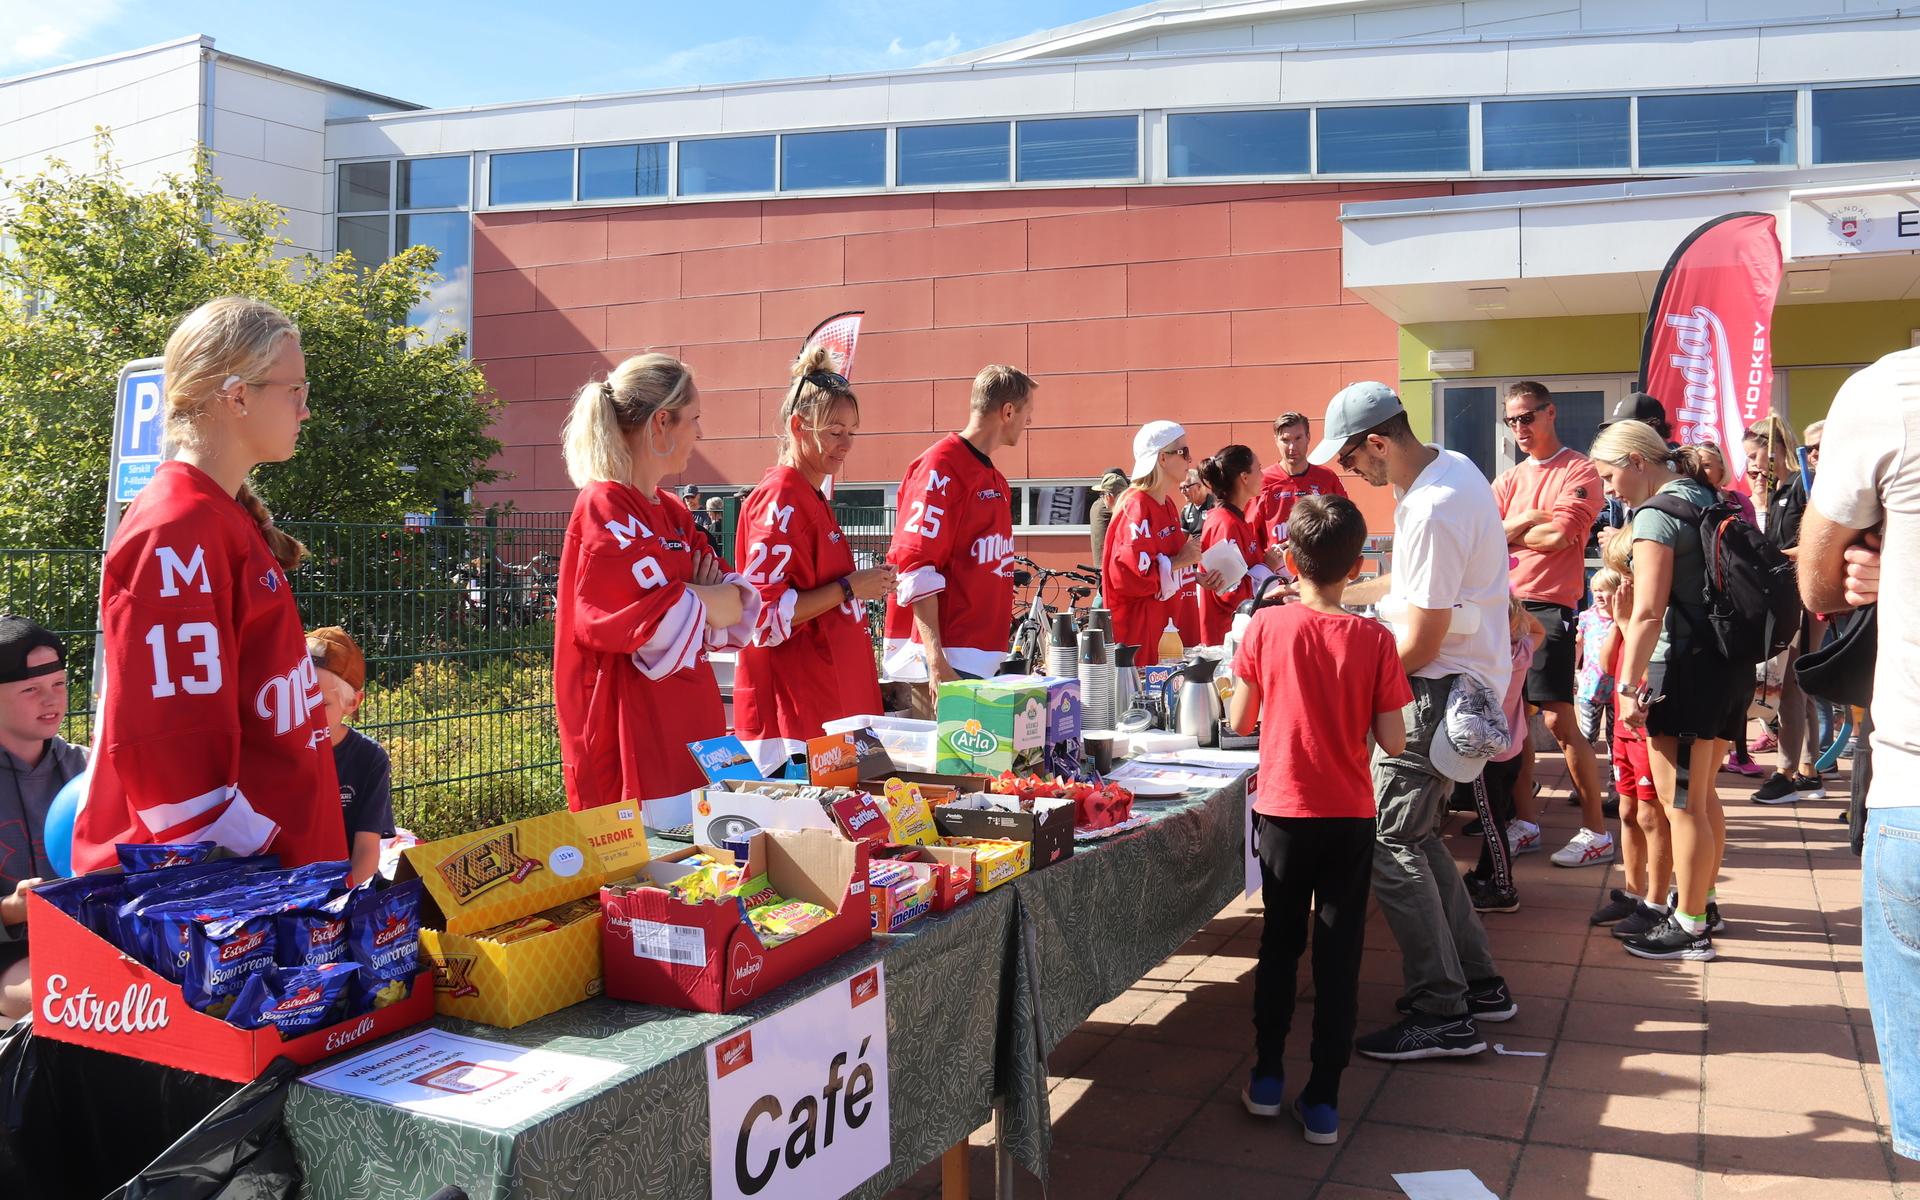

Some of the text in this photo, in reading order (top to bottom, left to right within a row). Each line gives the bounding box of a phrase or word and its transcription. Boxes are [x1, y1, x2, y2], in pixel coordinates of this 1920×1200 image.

[1666, 306, 1722, 446] ölndal
[1744, 321, 1766, 419] HOCKEY
[131, 382, 160, 449] P
[926, 469, 951, 496] M
[605, 513, 654, 550] M
[764, 500, 795, 534] M
[904, 501, 944, 539] 25
[1129, 519, 1151, 541] M
[155, 544, 212, 598] M
[632, 555, 669, 590] 9
[743, 542, 793, 585] 22
[145, 621, 223, 699] 13
[957, 733, 989, 749] Arla
[812, 747, 841, 772] CORNY
[849, 809, 879, 830] Skittles
[588, 828, 634, 848] BLERONE
[444, 832, 517, 897] KEX
[745, 888, 776, 909] ARIBO
[893, 900, 930, 927] mentos
[222, 935, 263, 959] Estrella
[376, 923, 407, 945] Estrella
[211, 955, 274, 986] Sourcream
[433, 957, 472, 988] EX
[736, 961, 761, 980] Malaco
[42, 973, 170, 1034] Estrella
[325, 1017, 375, 1052] Estrella
[345, 1044, 430, 1078] Välkommen!
[735, 1034, 874, 1195] Café
